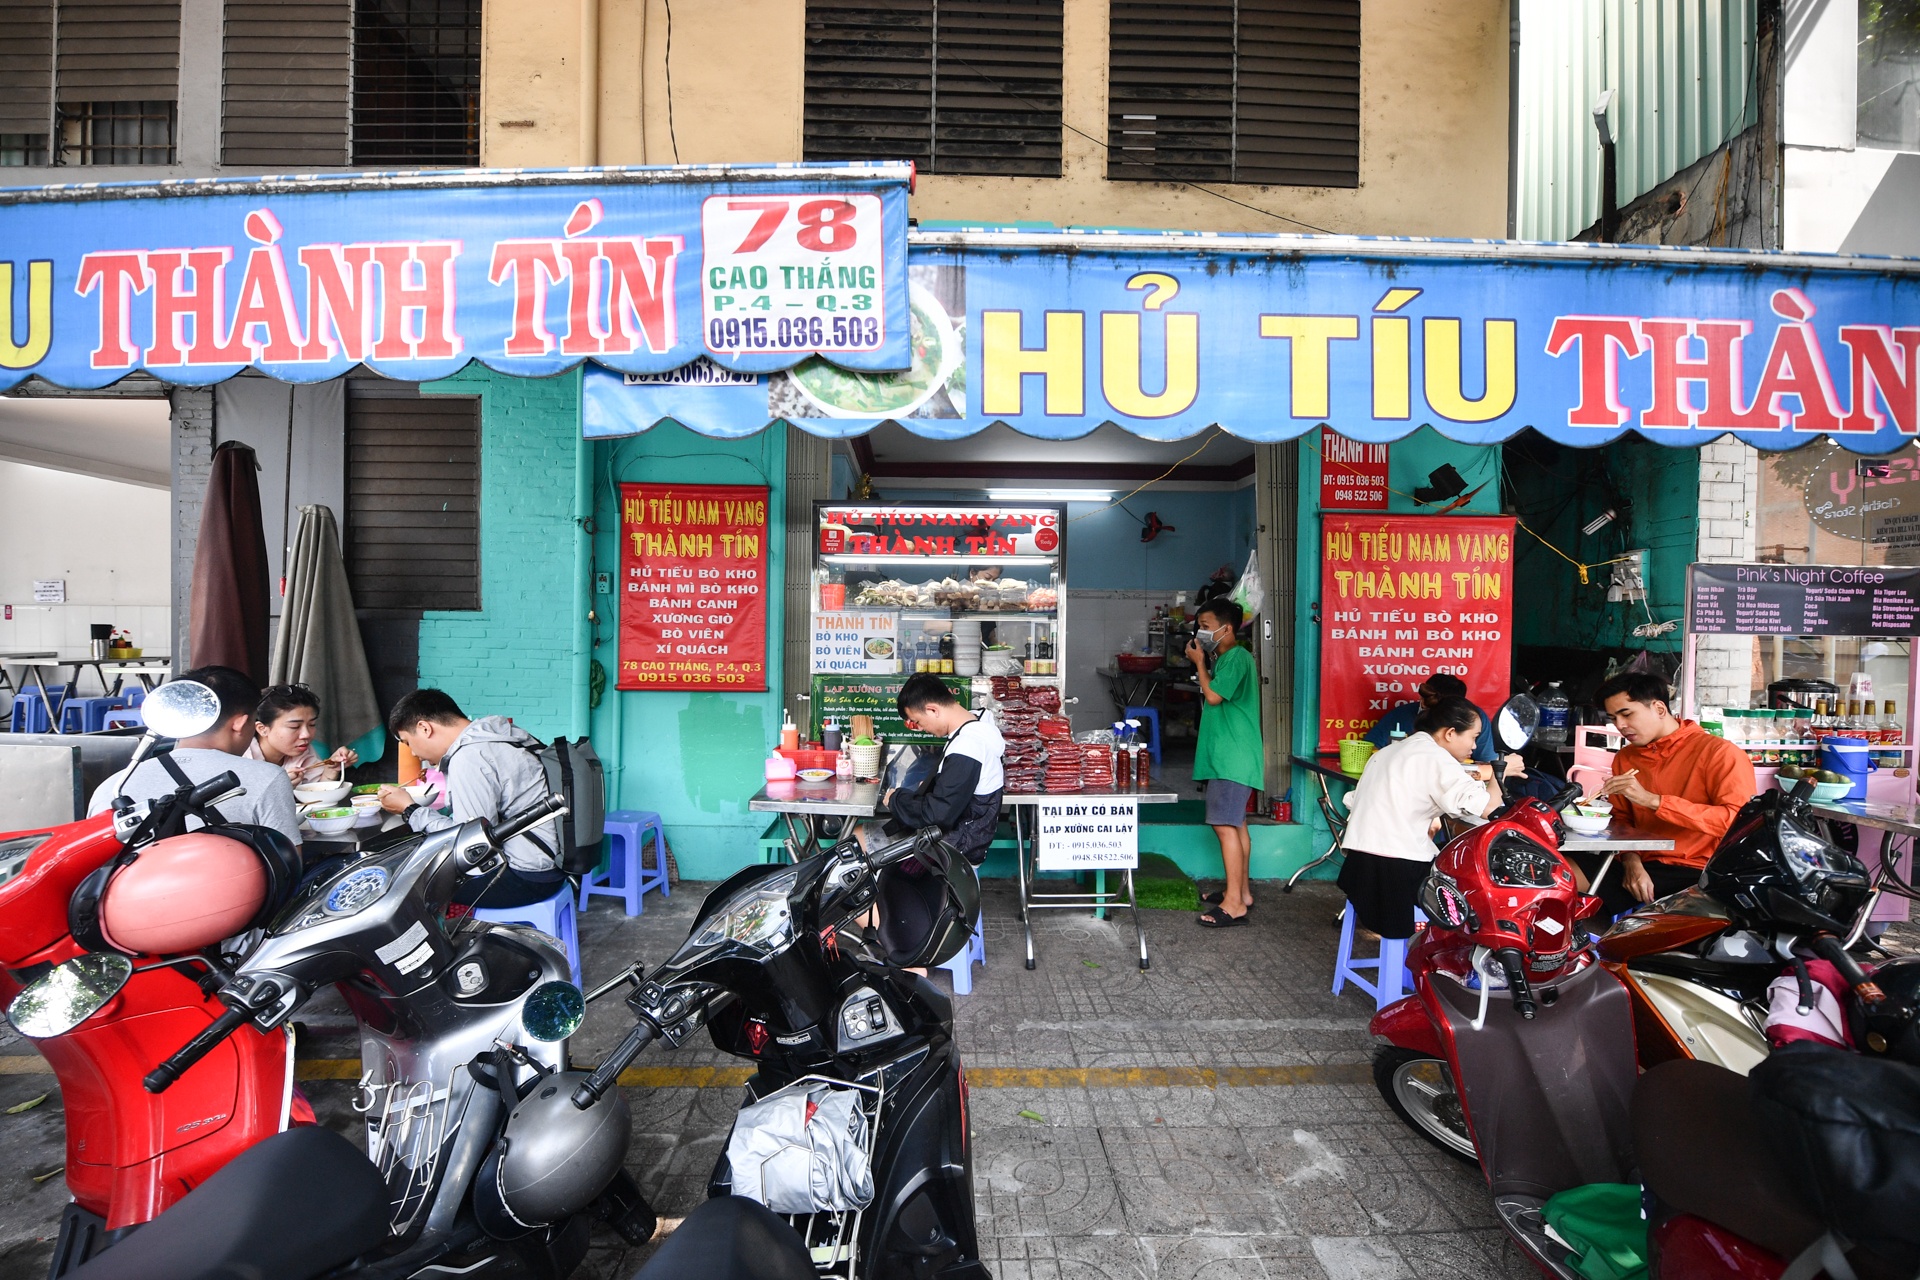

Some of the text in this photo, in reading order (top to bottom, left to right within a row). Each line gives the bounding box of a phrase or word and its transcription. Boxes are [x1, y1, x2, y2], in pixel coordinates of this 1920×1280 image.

[726, 199, 858, 254] 78
[709, 256, 876, 290] CAO THẮNG
[74, 208, 465, 369] THÀNH
[487, 198, 684, 356] TÍN
[713, 295, 873, 313] P.4 Q.3
[710, 316, 879, 351] 0915.036.503
[981, 271, 1199, 419] HỦ
[1260, 287, 1518, 422] TÍU
[1337, 475, 1354, 486] 0915
[1356, 476, 1369, 486] 036
[1371, 476, 1384, 486] 503
[1335, 490, 1383, 501] 0948 522 506
[624, 491, 764, 526] HỦ TIẾU NAM VANG
[827, 509, 863, 525] HỦ
[871, 508, 916, 526] TÍU
[631, 527, 758, 558] THÀNH TÍN
[849, 529, 1018, 556] THÀNH TÍN
[1326, 522, 1509, 564] HỦ TIẾU NAM VANG
[630, 565, 757, 579] HỦ TIẾU BÒ KHO
[1737, 568, 1884, 586] Pink's Night Coffee
[628, 581, 758, 594] BÁNH MÌ BÒ KHO
[1334, 565, 1501, 600] THÀNH TÍN
[649, 597, 737, 609] BÁNH CANH
[652, 613, 733, 625] XƯƠNG GIÒ
[816, 613, 892, 630] THÀNH TÍN
[1334, 608, 1498, 623] HỦ TIẾU BÒ KHO
[662, 628, 724, 639] BÒ VIÊN
[816, 631, 858, 641] BÒ KHO
[1331, 627, 1501, 641] BÁNH MÌ BÒ KHO
[656, 643, 728, 655] XÍ QUÁCH
[816, 645, 860, 655] BÒ VIÊN
[1359, 645, 1473, 659] BÁNH CANH
[623, 659, 761, 673] 78 CAO THẮNG, P.4, Q.3
[815, 659, 867, 670] XÍ QUÁCH
[1363, 662, 1468, 676] XƯƠNG GIÒ
[638, 673, 745, 683] 0915 036 503
[1375, 680, 1404, 693] BÒ
[1369, 697, 1388, 710] XÍ
[1325, 719, 1344, 729] 78
[1042, 804, 1133, 818] TẠI ĐÂY CÓ BÁN
[1043, 826, 1061, 835] LẠP
[1064, 823, 1094, 833] XƯỞNG
[1097, 825, 1112, 833] CAI
